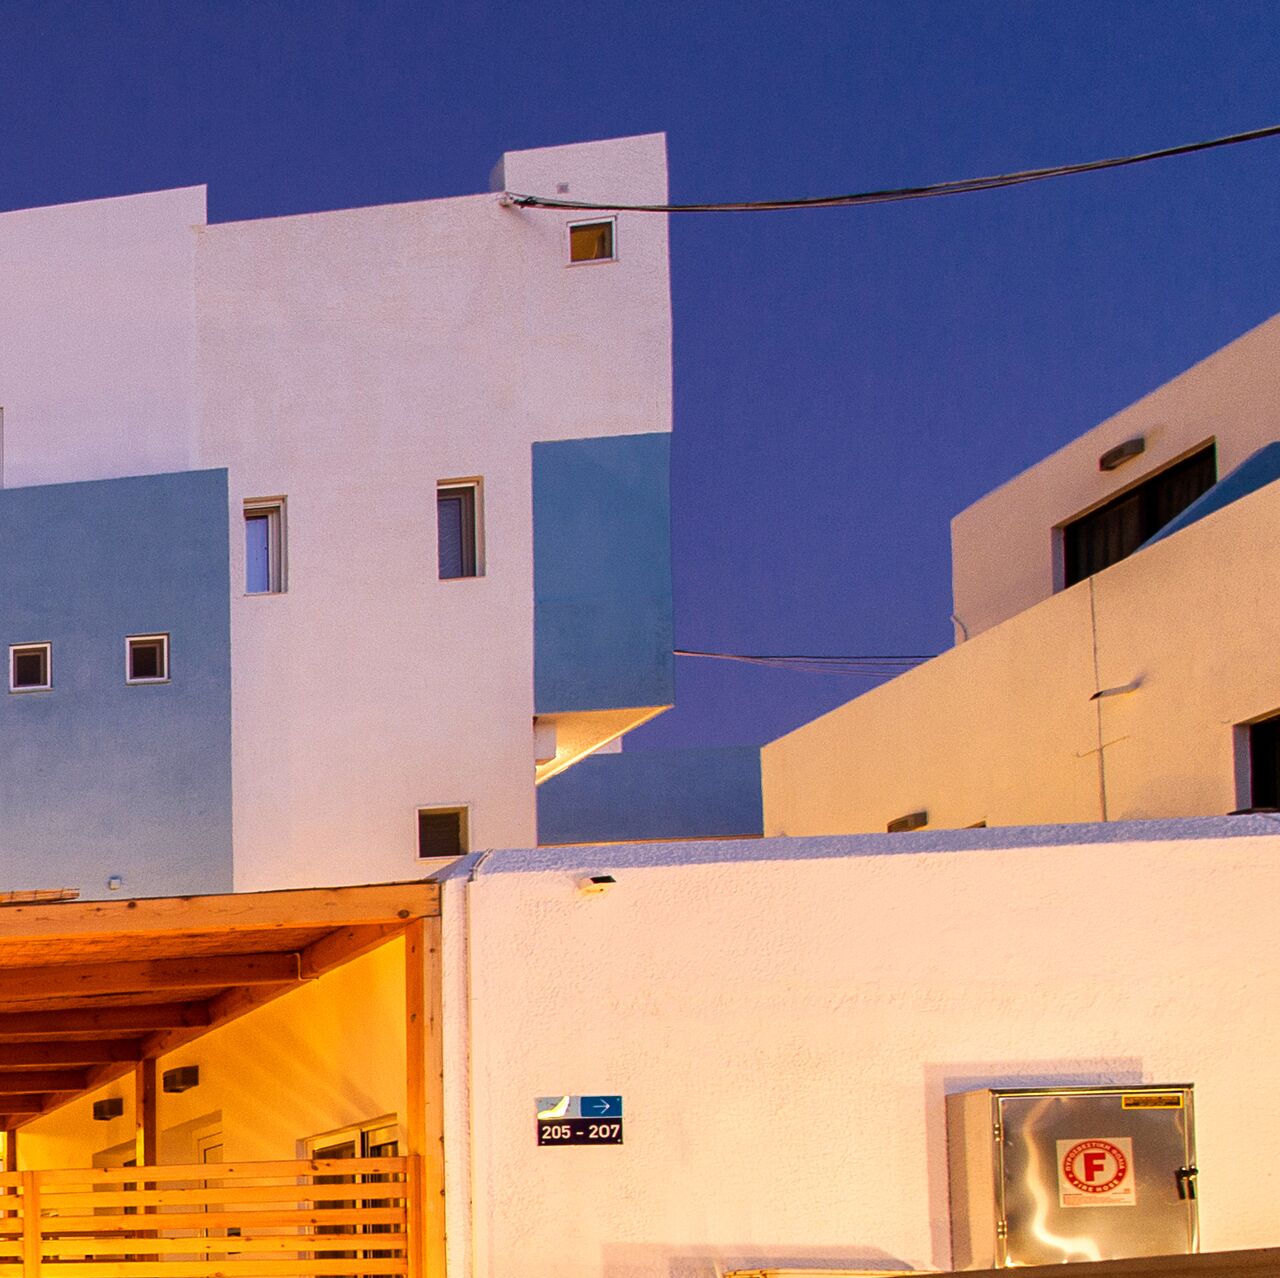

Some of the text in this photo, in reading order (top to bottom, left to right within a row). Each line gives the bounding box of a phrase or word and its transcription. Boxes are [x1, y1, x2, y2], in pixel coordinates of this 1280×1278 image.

[542, 1125, 571, 1139] 205
[588, 1124, 620, 1138] 207
[1084, 1152, 1106, 1182] F
[1072, 1180, 1094, 1192] FIRE
[1095, 1179, 1119, 1192] HOSE
